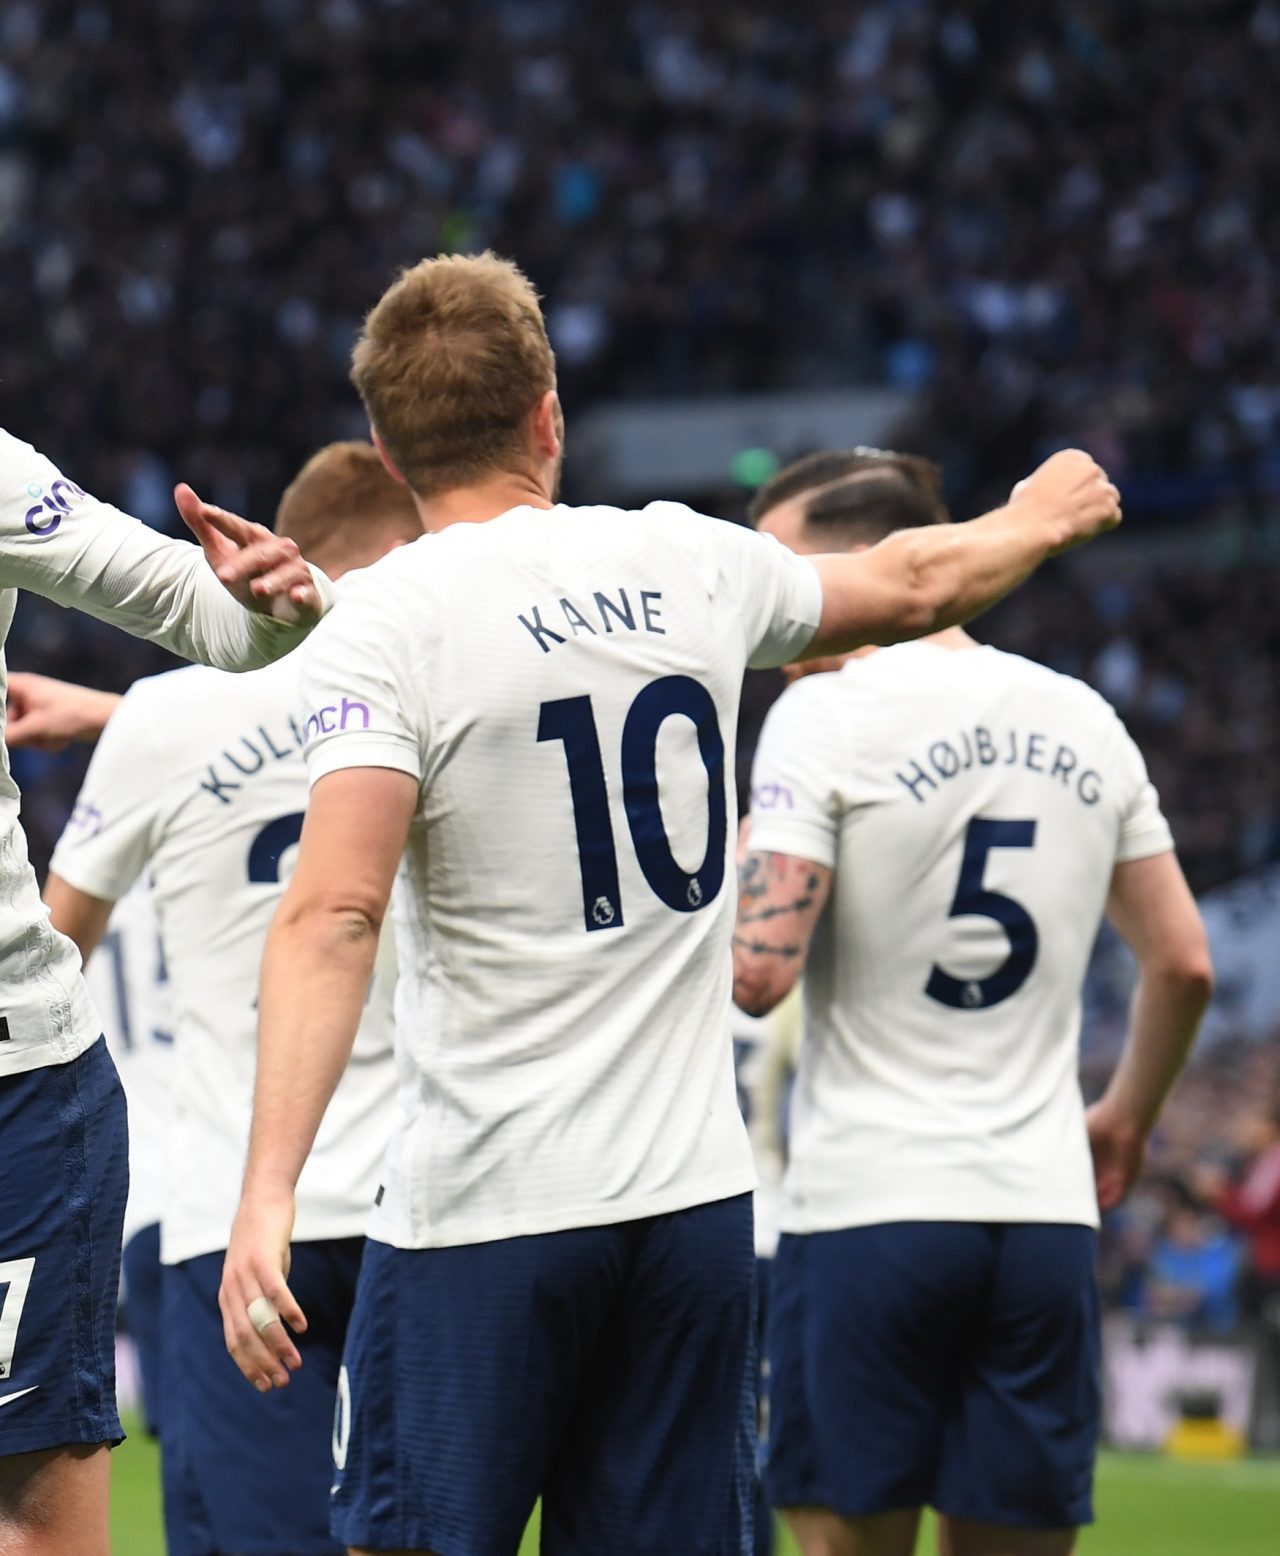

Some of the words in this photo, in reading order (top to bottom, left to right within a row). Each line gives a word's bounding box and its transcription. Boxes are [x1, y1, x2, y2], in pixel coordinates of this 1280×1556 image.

[517, 588, 666, 653] KANE
[303, 697, 369, 743] nch
[536, 675, 727, 932] 10
[896, 727, 1105, 807] HØJBJERG
[924, 817, 1039, 1011] 5
[331, 1364, 352, 1470] 0
